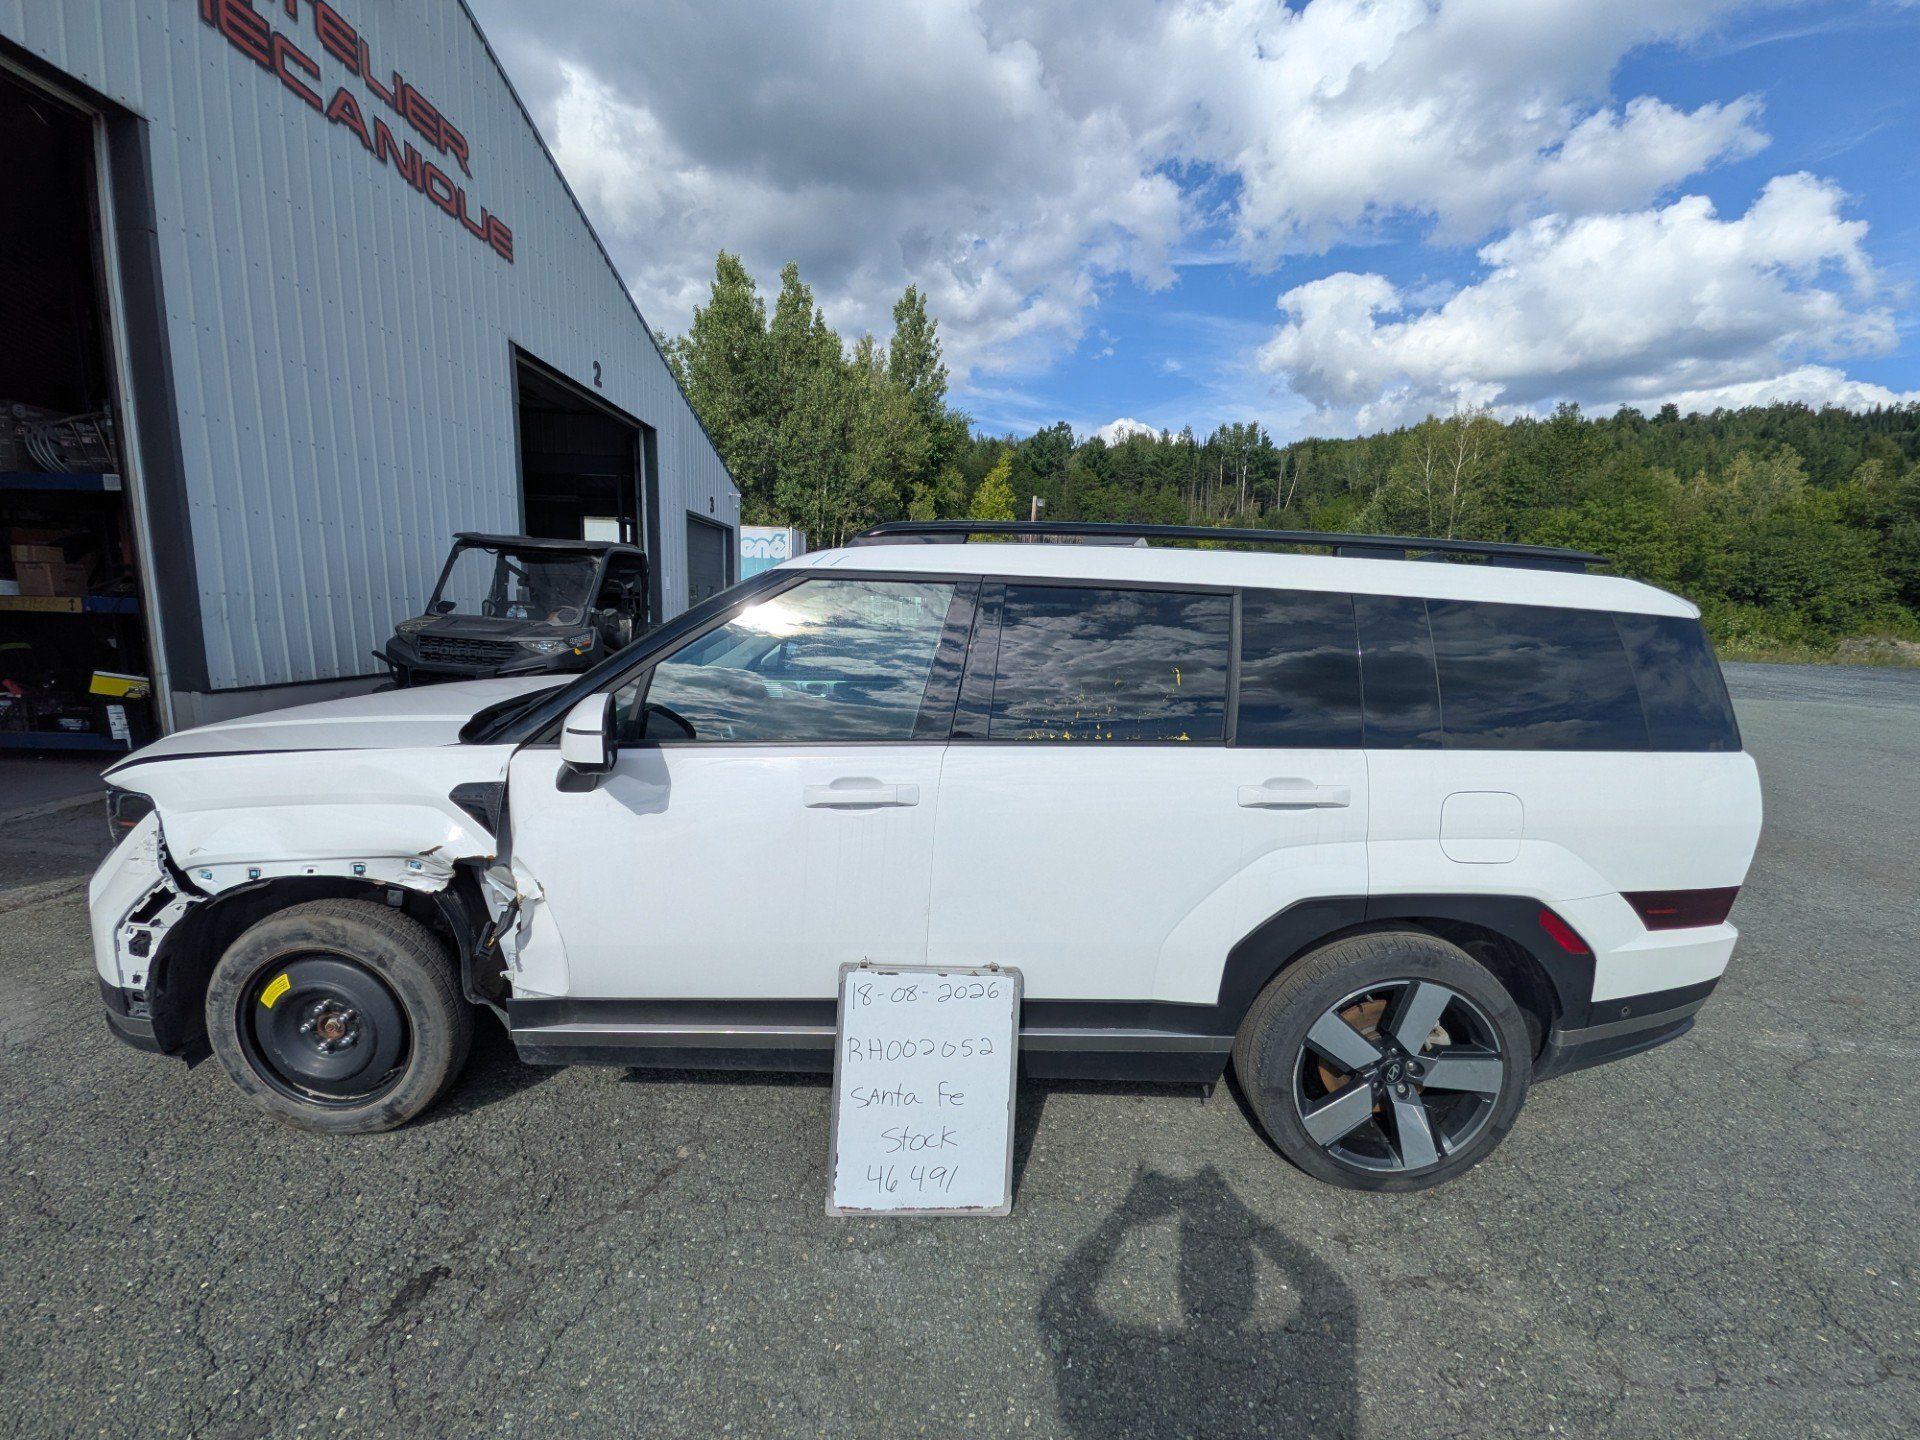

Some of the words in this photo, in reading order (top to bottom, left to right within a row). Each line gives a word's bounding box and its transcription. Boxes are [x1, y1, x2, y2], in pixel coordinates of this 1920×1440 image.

[592, 360, 603, 389] 2
[709, 496, 715, 514] 3
[847, 1037, 994, 1063] RH002052
[938, 1081, 965, 1107] Fe
[881, 1125, 958, 1153] Stock
